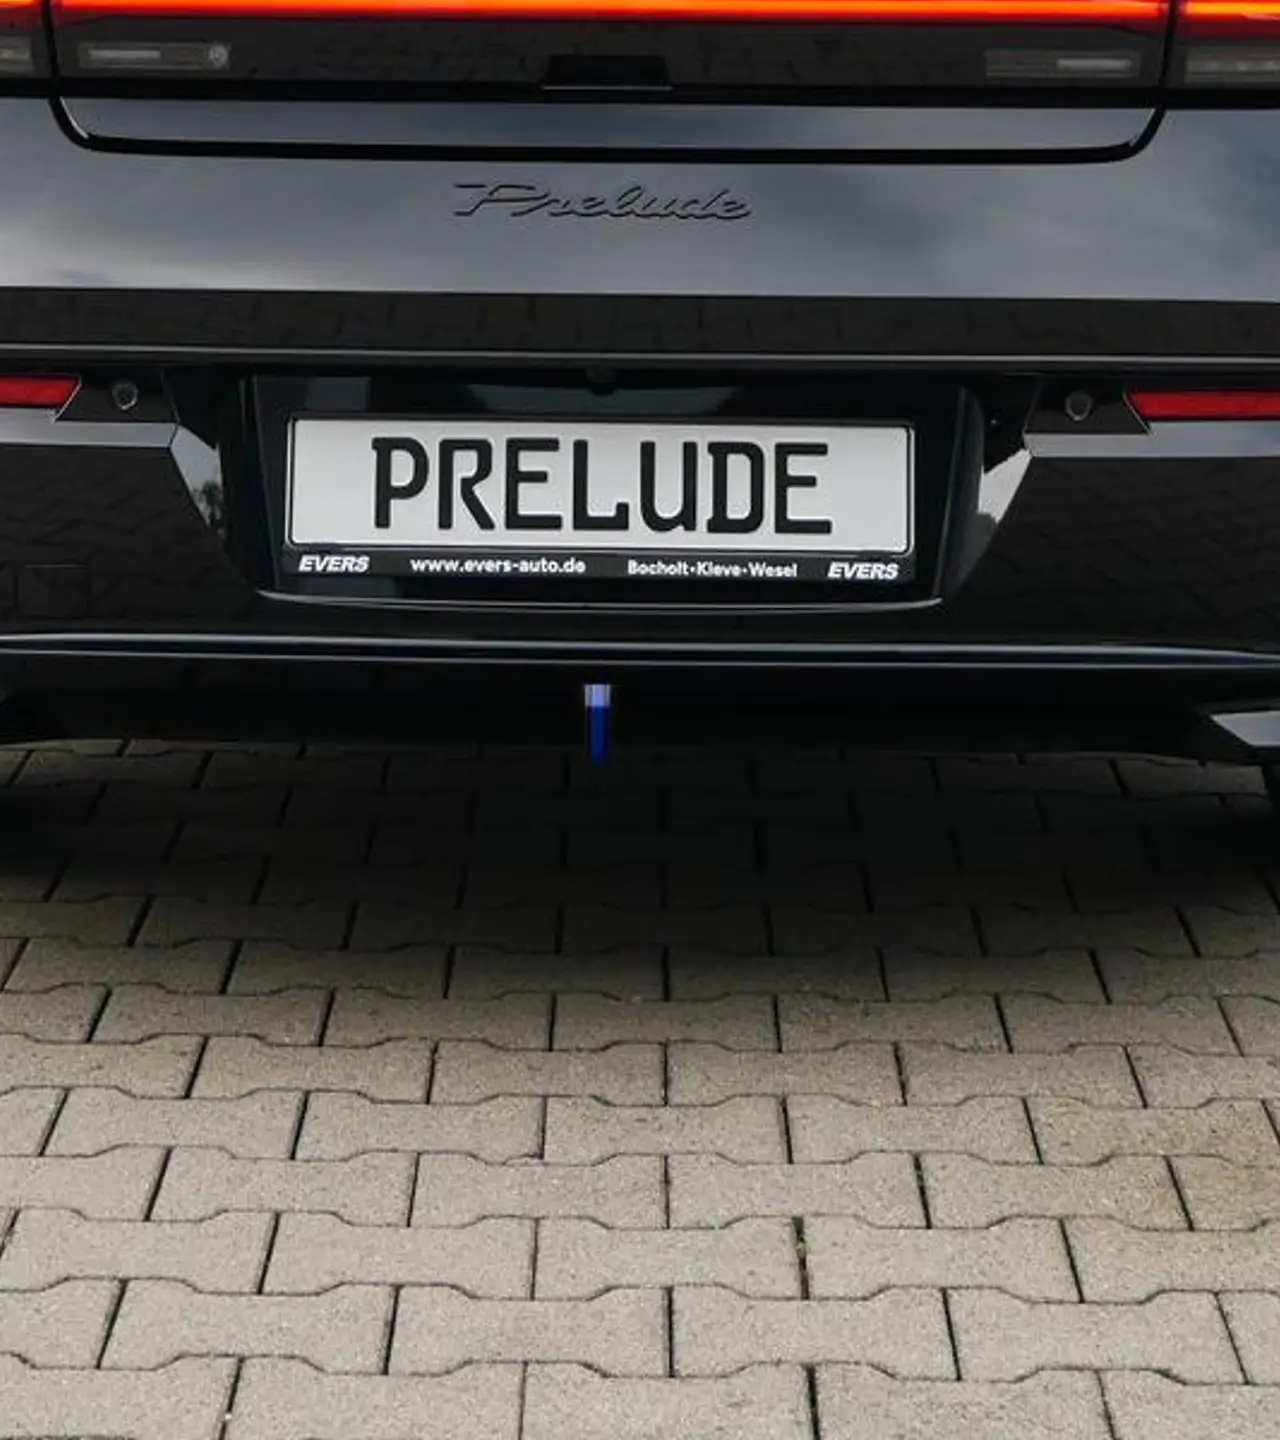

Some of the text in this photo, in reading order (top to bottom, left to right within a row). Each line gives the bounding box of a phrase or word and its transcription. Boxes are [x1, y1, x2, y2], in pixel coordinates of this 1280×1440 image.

[453, 183, 752, 220] Prelude
[371, 436, 833, 534] PRELUDE
[298, 555, 370, 573] EVERS
[410, 557, 587, 574] www.evers-auto.de
[828, 562, 900, 580] EVERS
